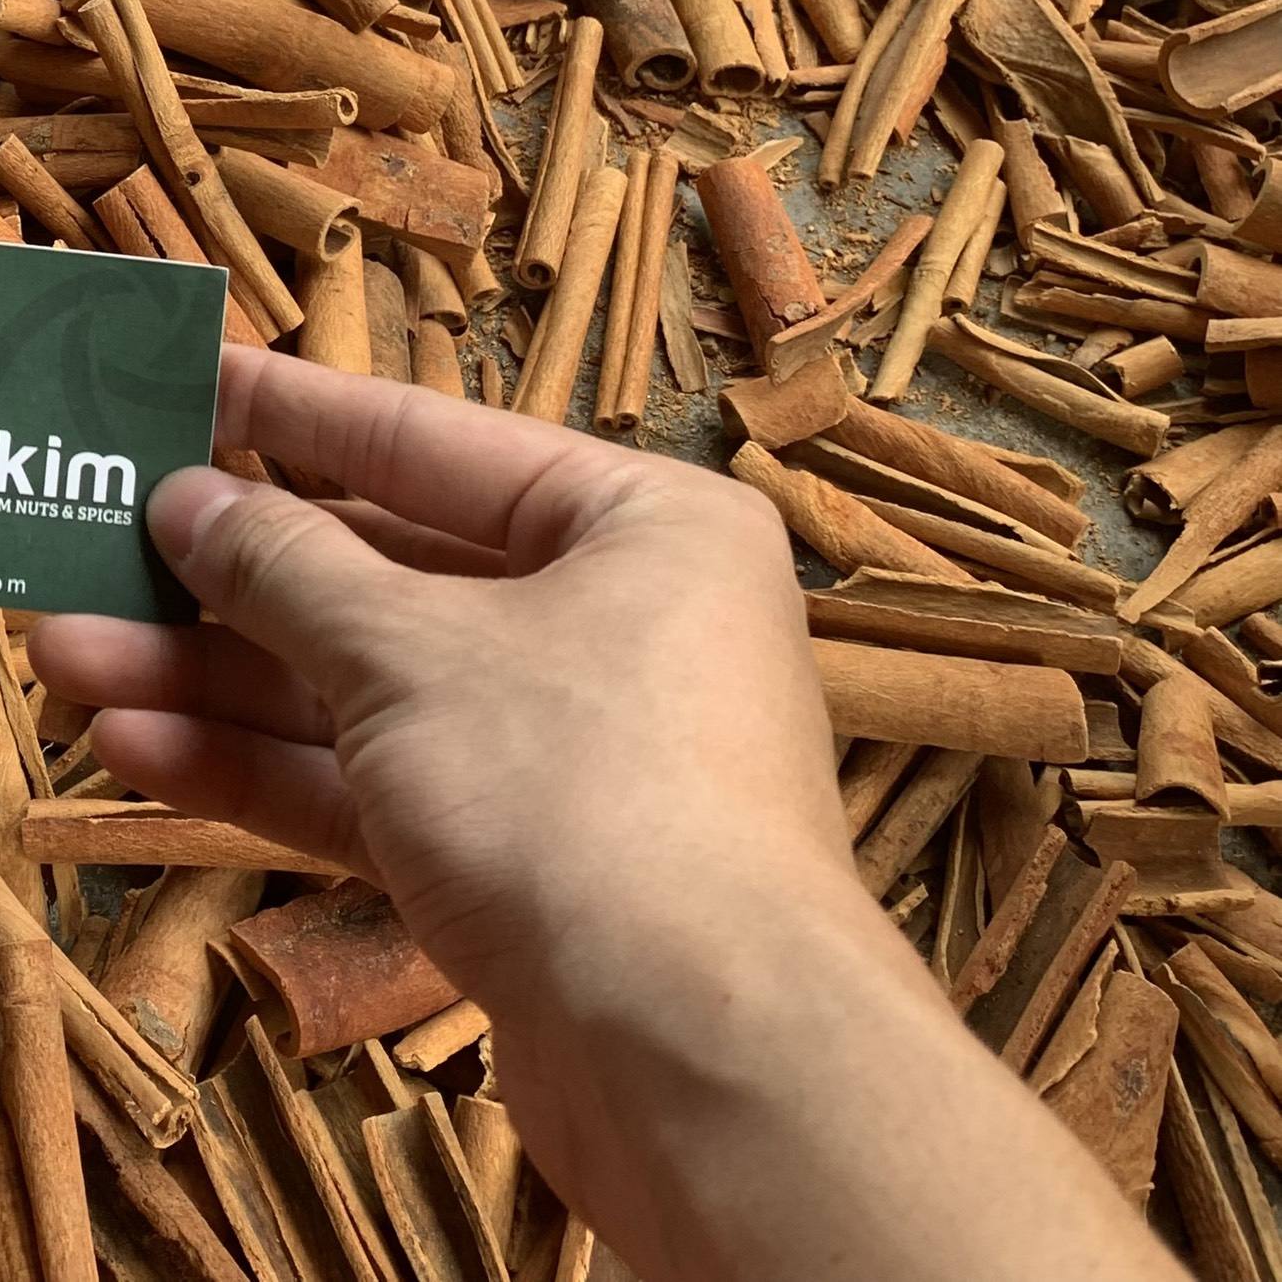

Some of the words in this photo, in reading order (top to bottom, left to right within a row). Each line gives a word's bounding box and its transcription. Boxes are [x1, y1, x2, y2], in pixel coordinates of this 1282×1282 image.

[15, 499, 59, 518] NUTS
[62, 503, 74, 520] &
[77, 506, 133, 526] SPICES
